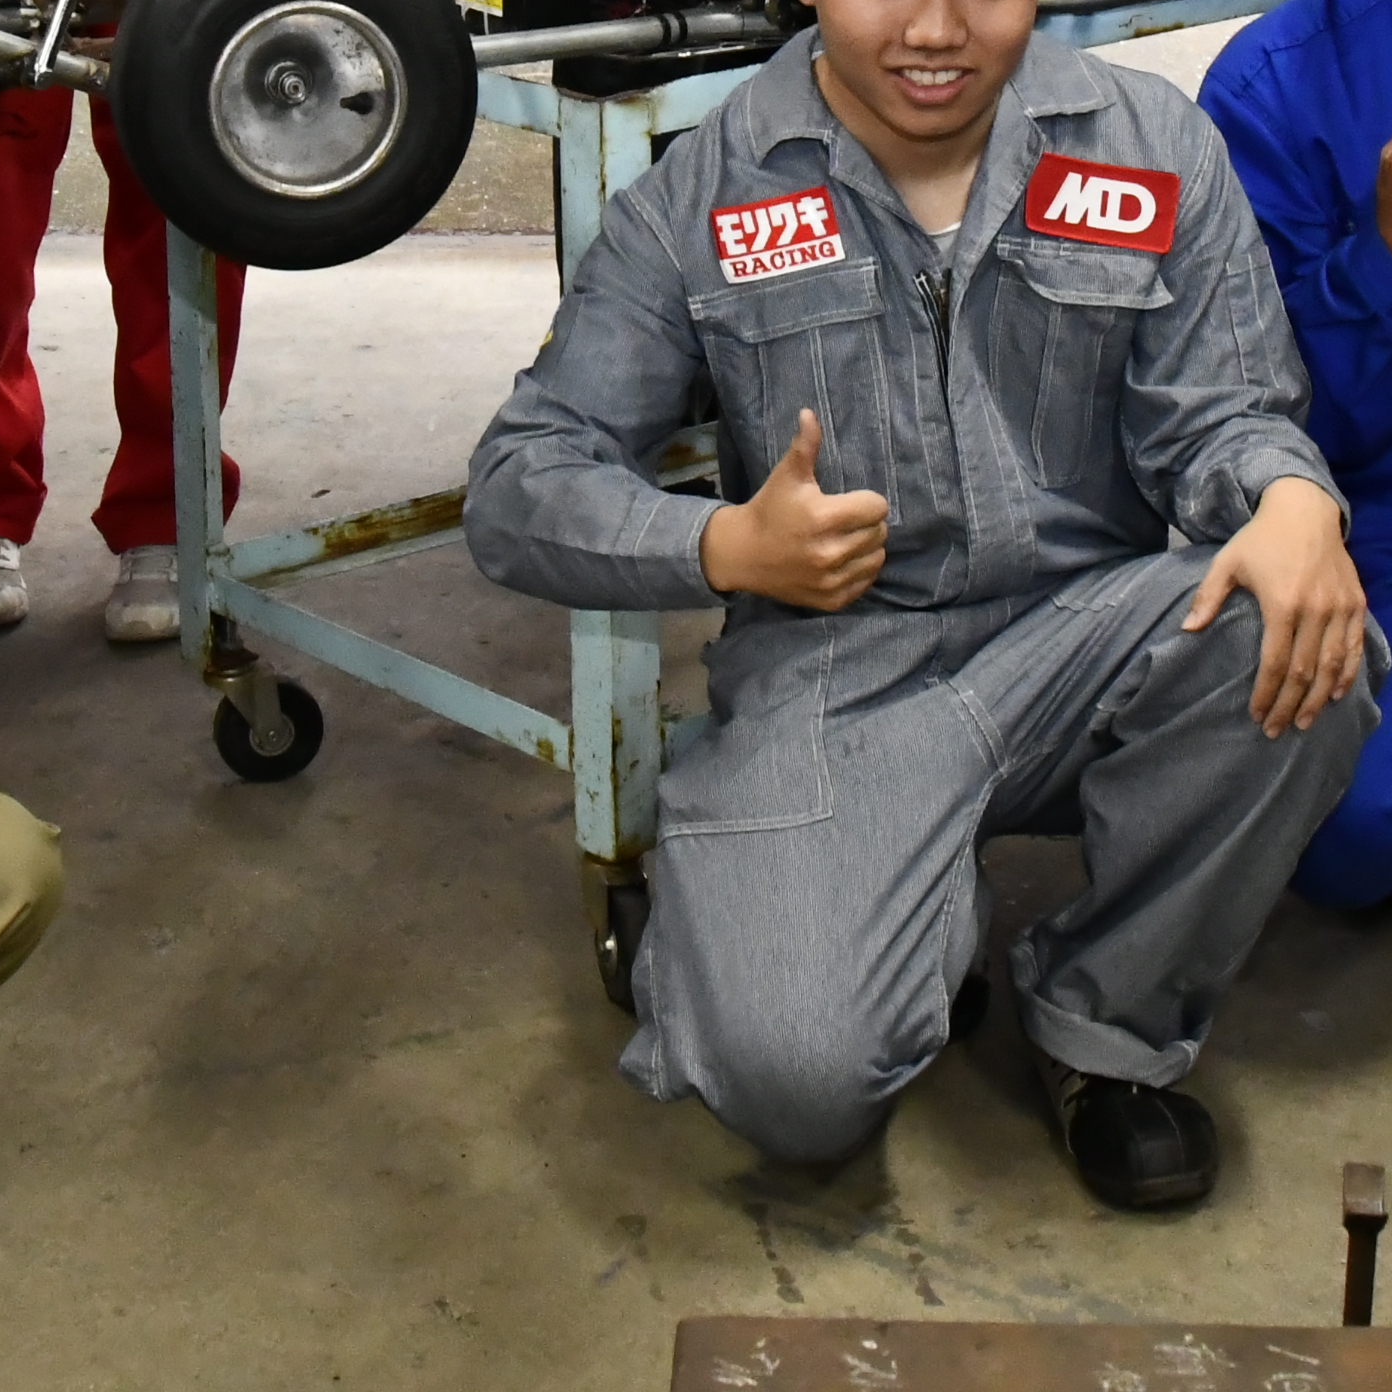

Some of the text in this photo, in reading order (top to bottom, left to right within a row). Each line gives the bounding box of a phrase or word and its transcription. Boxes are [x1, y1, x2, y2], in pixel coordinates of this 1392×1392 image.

[715, 196, 828, 256] モリワキ
[1043, 171, 1157, 234] MD
[728, 240, 837, 278] RACING
